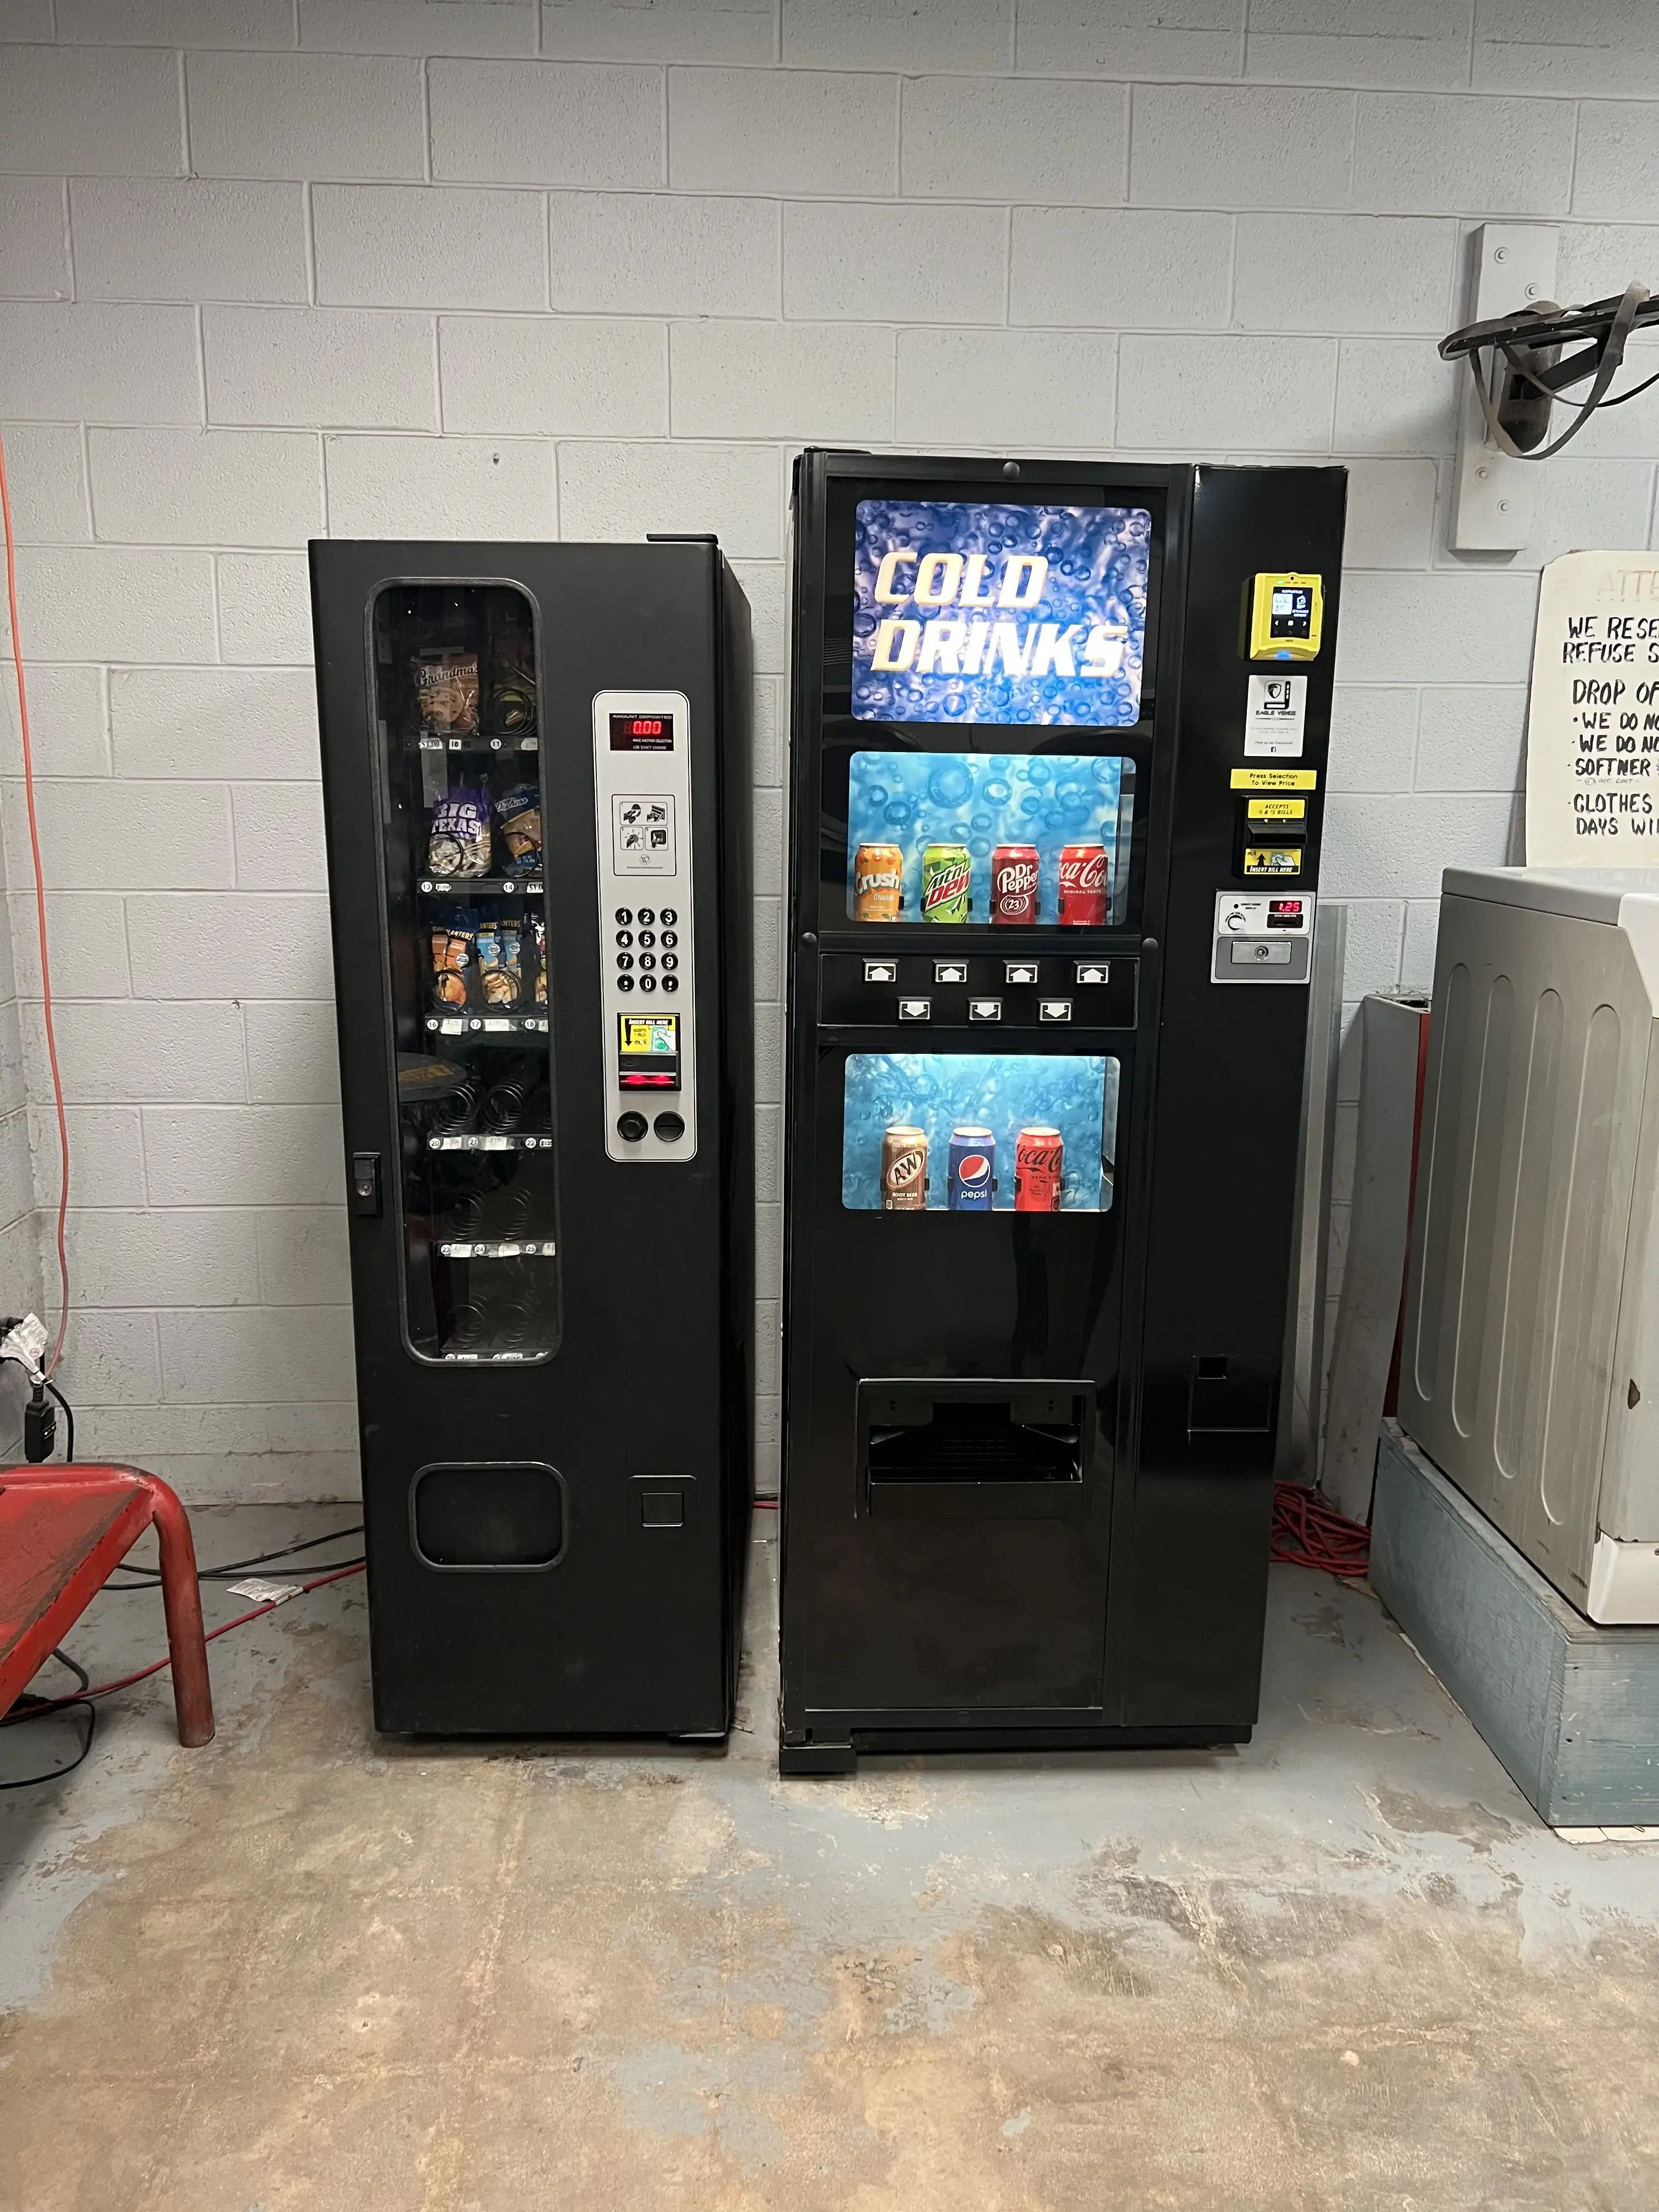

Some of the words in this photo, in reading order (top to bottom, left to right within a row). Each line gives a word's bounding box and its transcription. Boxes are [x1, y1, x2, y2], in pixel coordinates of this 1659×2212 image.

[874, 551, 1049, 607] COLD
[1568, 616, 1598, 639] WE
[870, 619, 1128, 678] DRINKS
[1563, 641, 1636, 664] REFUSE
[1572, 679, 1626, 705] DROP
[1582, 712, 1611, 729] WE
[1620, 712, 1638, 731] DO
[1579, 734, 1607, 753] WE
[1616, 735, 1636, 753] DO
[1575, 758, 1651, 777] SOFTNER
[1573, 793, 1653, 814] CLOTHES
[1576, 817, 1619, 837] DAYS
[1015, 864, 1033, 879] Dr
[1008, 899, 1019, 910] 23
[1278, 902, 1300, 912] 1.25
[621, 911, 627, 922] 1
[643, 911, 650, 922] 2
[665, 911, 673, 923] 3
[620, 933, 628, 945] 4
[644, 934, 651, 945] 5
[665, 934, 673, 945] 6
[622, 956, 629, 967] 7
[644, 956, 651, 967] 8
[665, 956, 674, 967] 9
[645, 978, 652, 989] 0
[961, 1189, 987, 1200] pepsi
